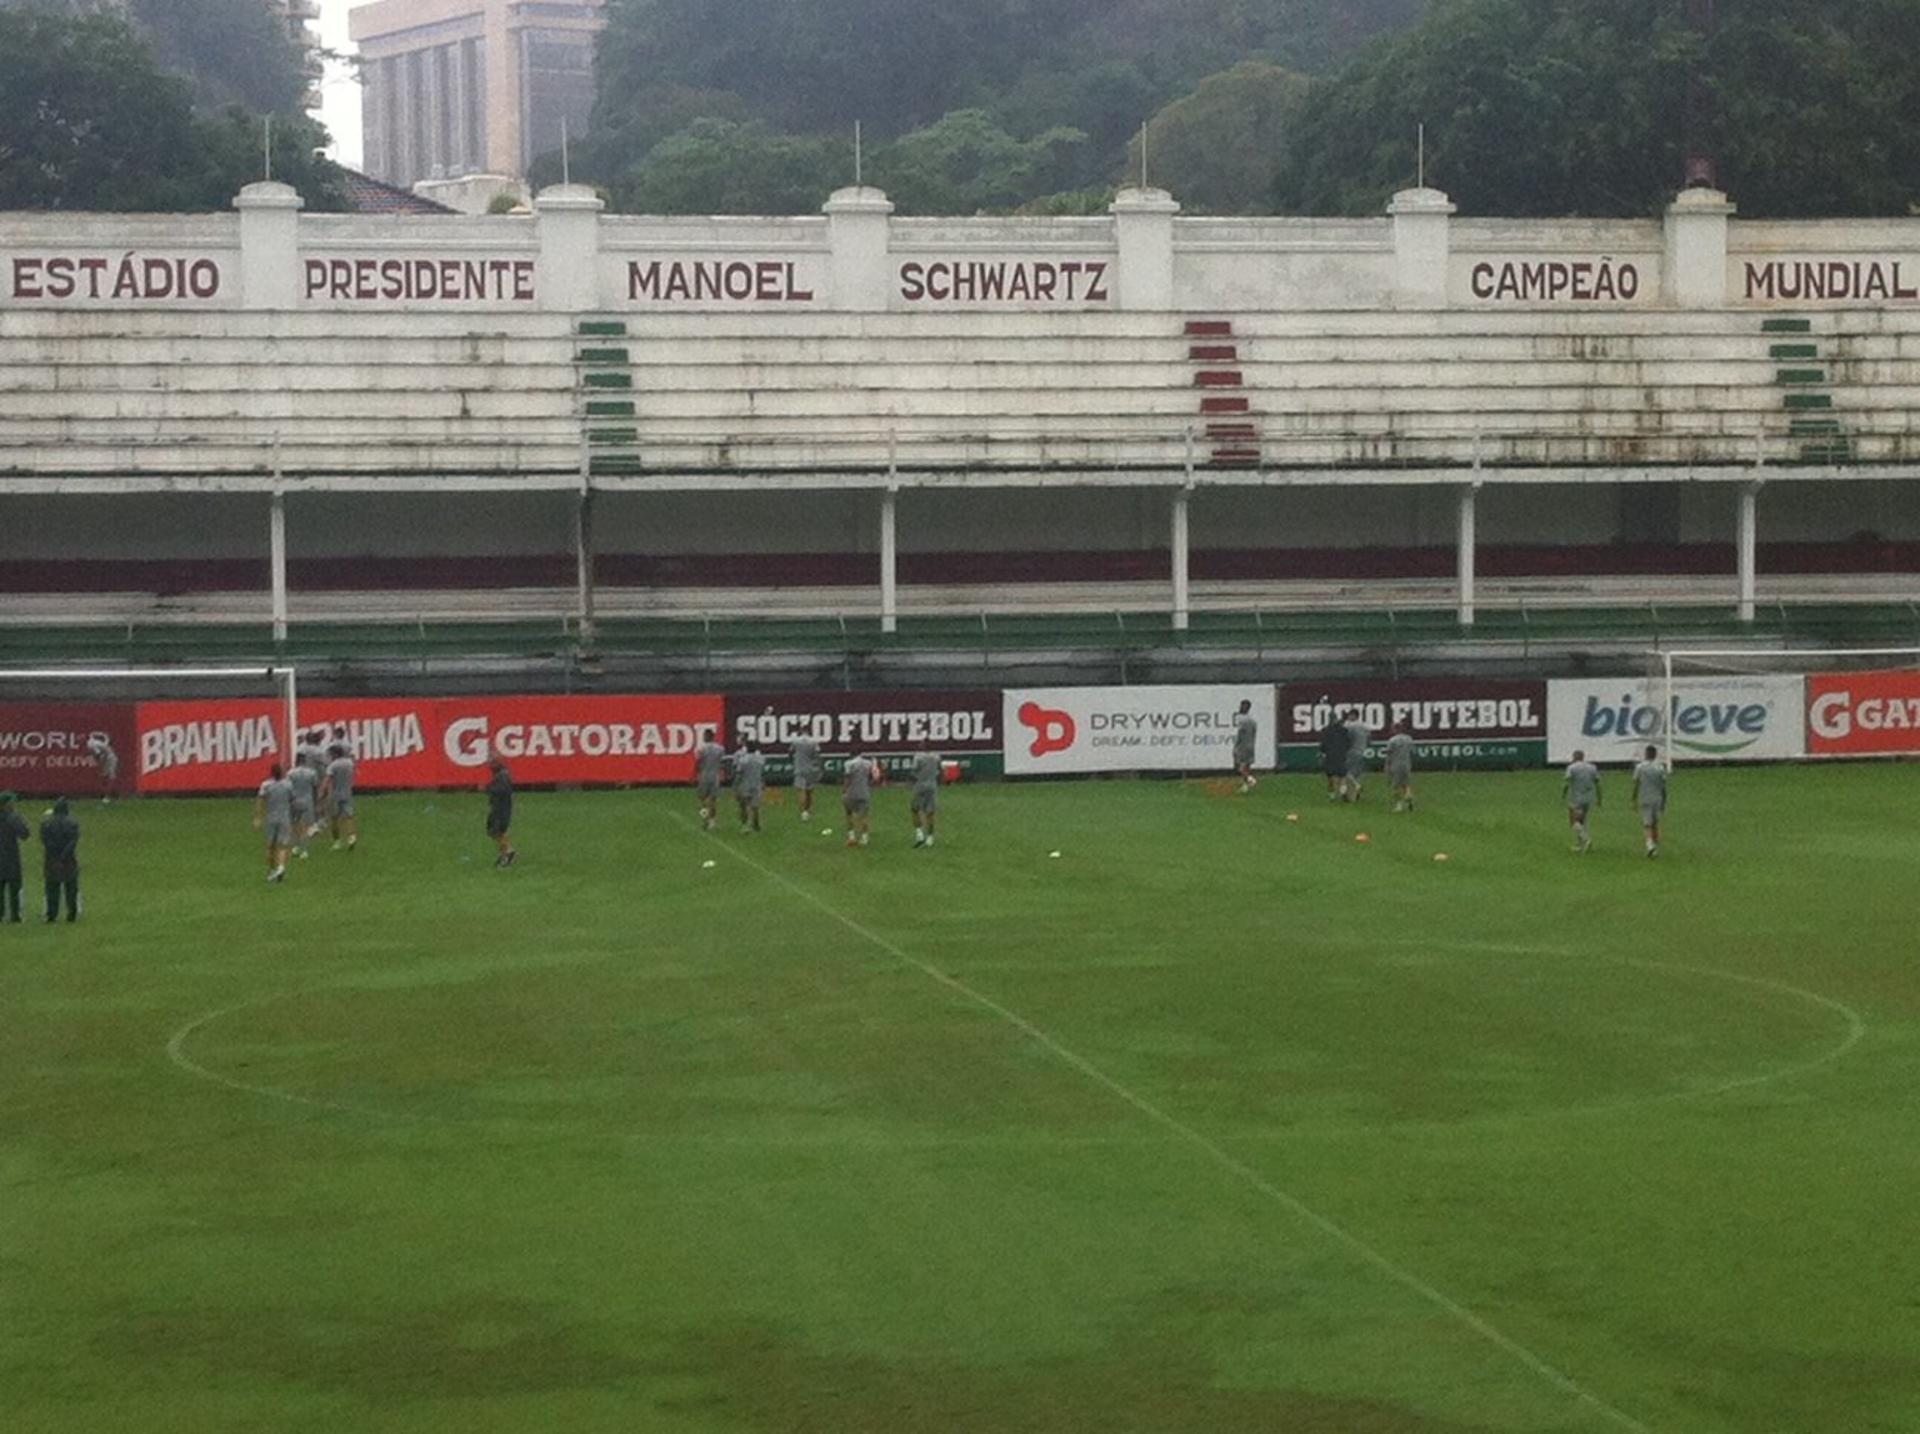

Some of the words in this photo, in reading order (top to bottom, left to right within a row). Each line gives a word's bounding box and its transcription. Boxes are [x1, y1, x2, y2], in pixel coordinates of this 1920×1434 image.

[12, 251, 219, 298] ESTÁDIO
[305, 260, 535, 299] PRESIDENTE
[628, 261, 814, 300] MANOEL
[901, 262, 1108, 300] SCHWARTZ
[1471, 256, 1639, 300] CAMPEÃO
[1744, 262, 1918, 299] MUNDIAL
[838, 711, 992, 742] FUTEBOL
[1391, 699, 1539, 730] FUTEBOL
[1582, 694, 1767, 737] bioleve
[141, 715, 278, 775] BRAHMA
